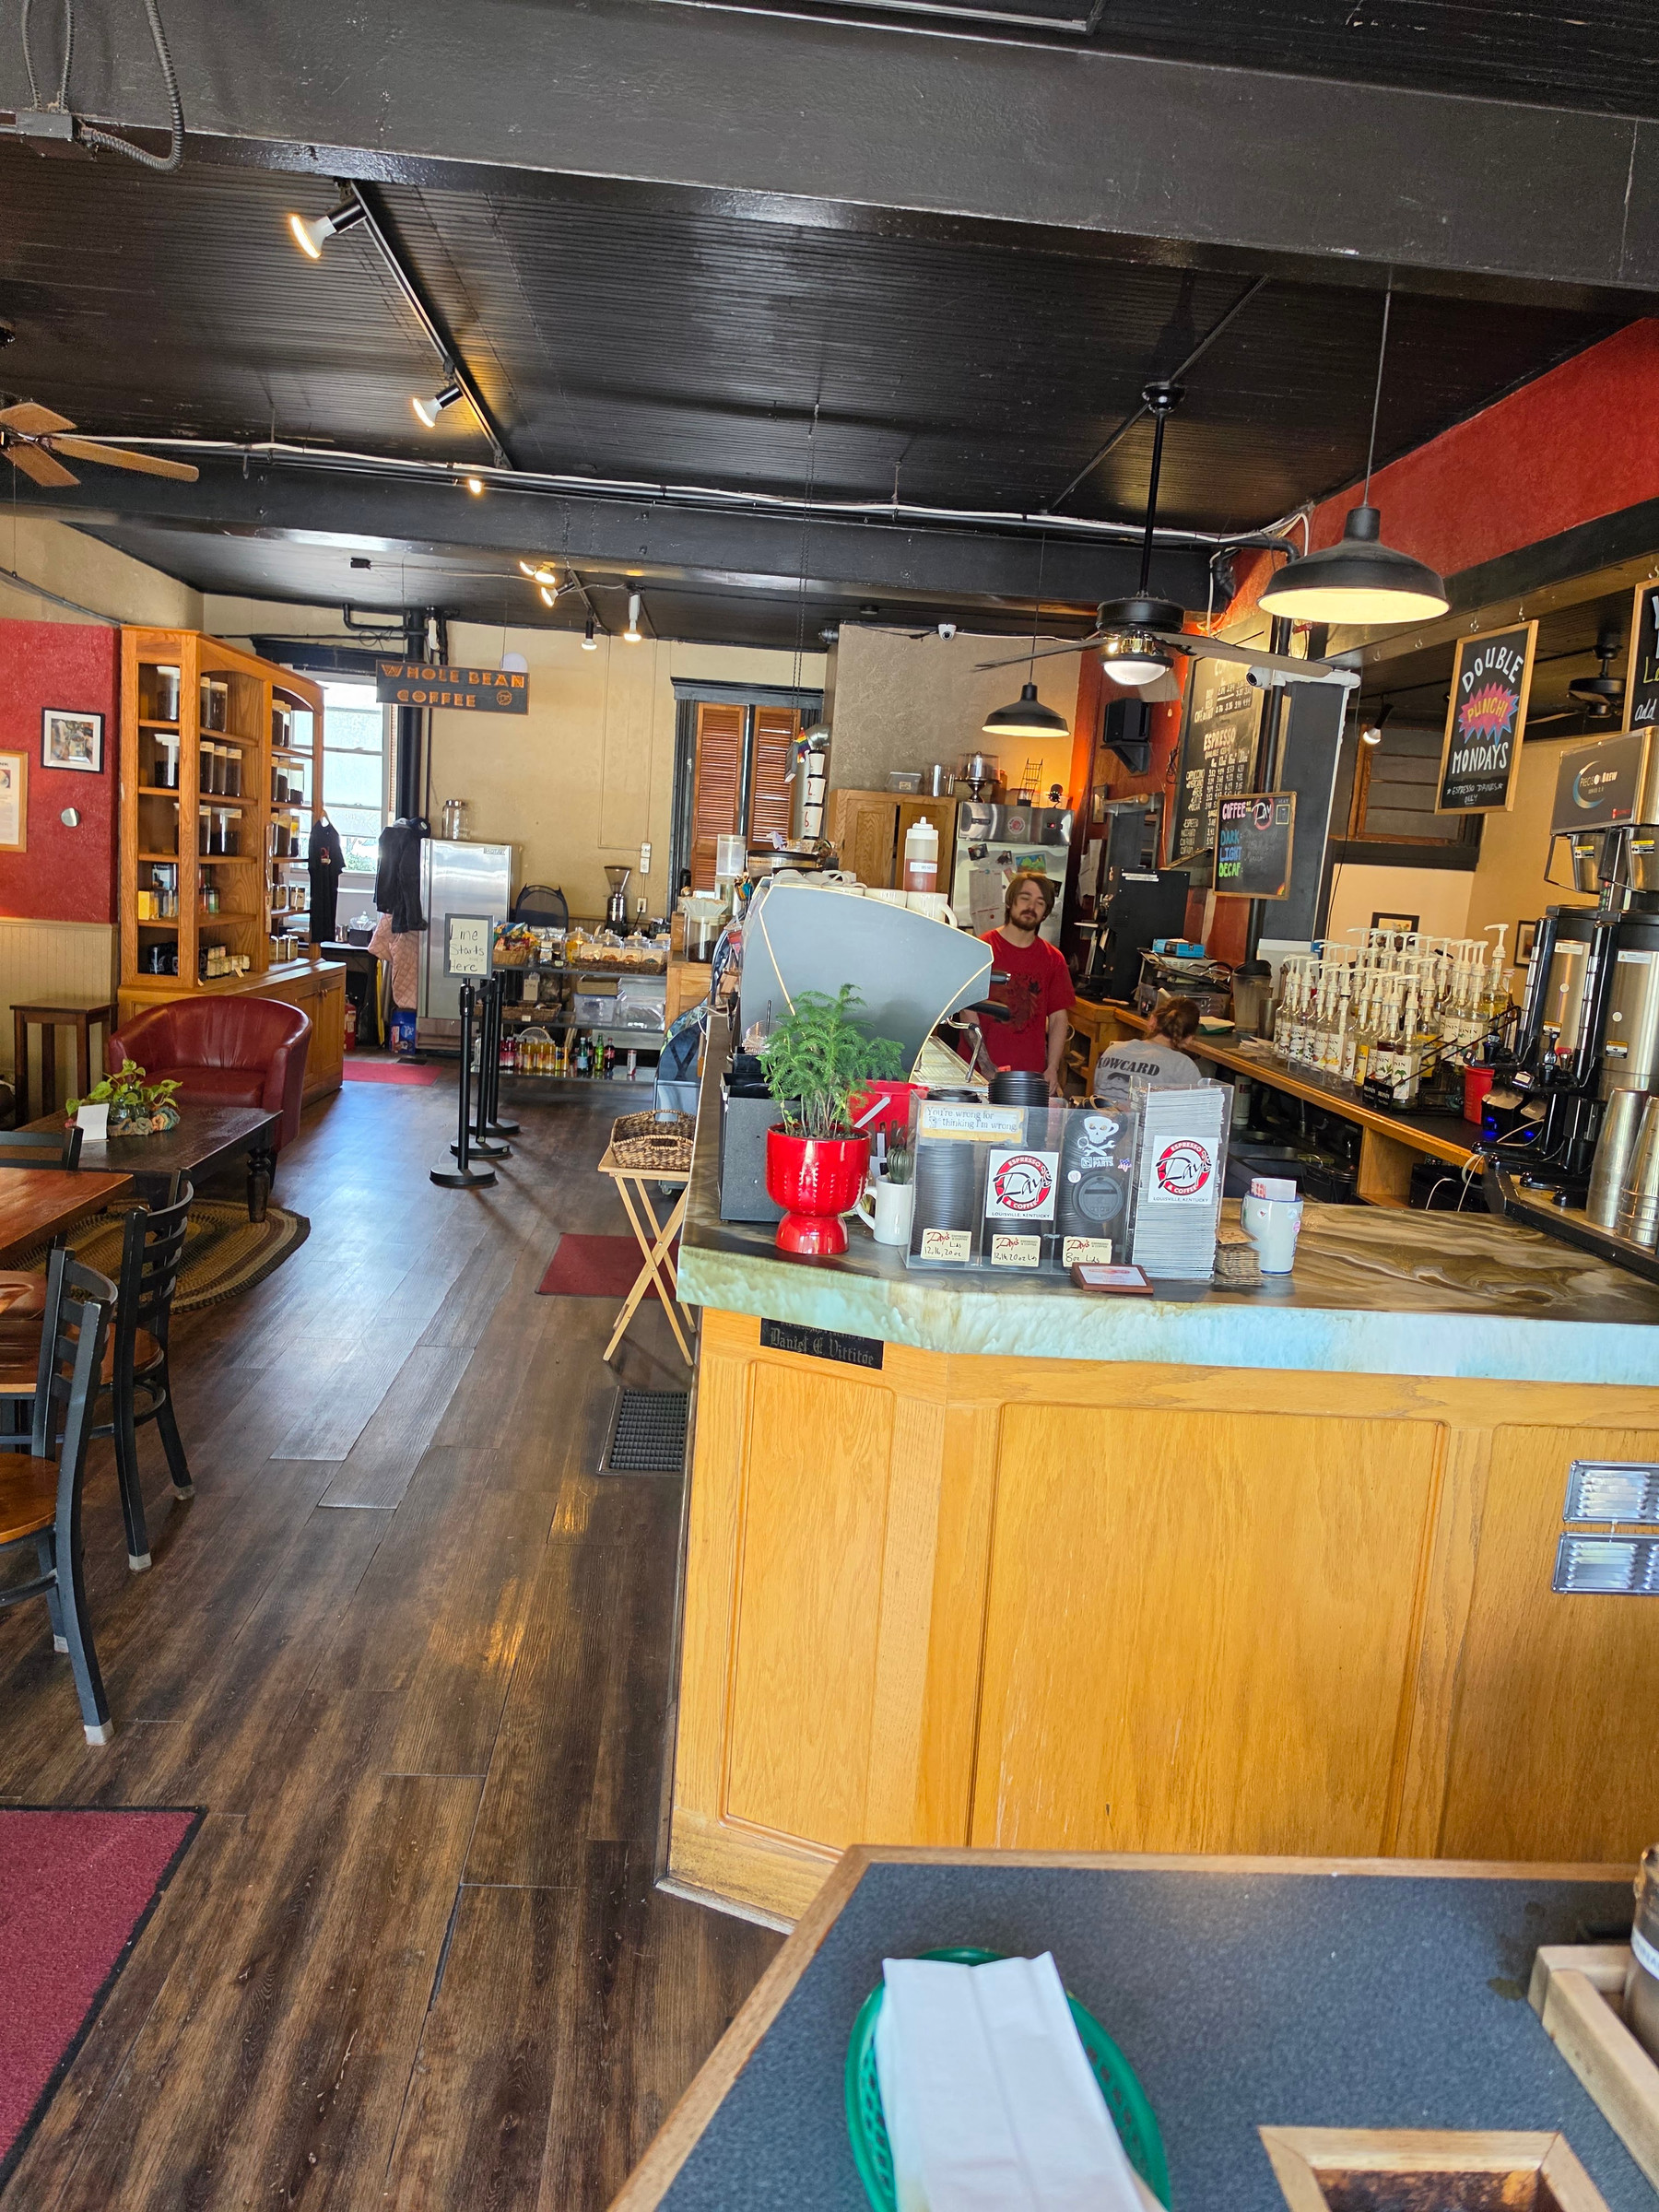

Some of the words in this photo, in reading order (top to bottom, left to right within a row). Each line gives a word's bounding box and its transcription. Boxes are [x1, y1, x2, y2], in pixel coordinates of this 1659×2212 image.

[381, 664, 460, 683] WHOLE
[468, 671, 524, 688] BEAN
[1462, 646, 1524, 693] DOUBLE
[397, 689, 477, 707] COFFEE
[1467, 697, 1508, 723] PUNCH!
[1635, 698, 1657, 722] add
[1204, 726, 1237, 752] ESPRESSO
[1452, 741, 1509, 775] MONDAYS
[1453, 783, 1476, 795] ESPRESSO
[1222, 801, 1247, 820] COFFEE
[1251, 801, 1273, 826] DAY
[450, 924, 478, 941] Line
[450, 943, 485, 957] Starts
[449, 959, 477, 972] Here
[926, 1106, 954, 1118] You're
[956, 1111, 982, 1119] wrong
[982, 1112, 994, 1120] for
[942, 1118, 974, 1130] thinking
[976, 1119, 988, 1129] I'm
[991, 1122, 1018, 1133] wrong
[1171, 1142, 1202, 1152] ESPRESSO
[1007, 1157, 1041, 1168] ESPRESSO
[1092, 1159, 1114, 1168] PARTS
[1155, 1151, 1212, 1189] Day's
[993, 1166, 1052, 1205] Day's
[1173, 1184, 1198, 1194] COFFEE
[1013, 1200, 1038, 1210] COFFEE
[926, 1231, 950, 1245] Day's
[995, 1237, 1019, 1251] Day's
[1066, 1239, 1090, 1253] Day's
[1085, 1254, 1100, 1264] Lids
[770, 1326, 809, 1354] Daniel
